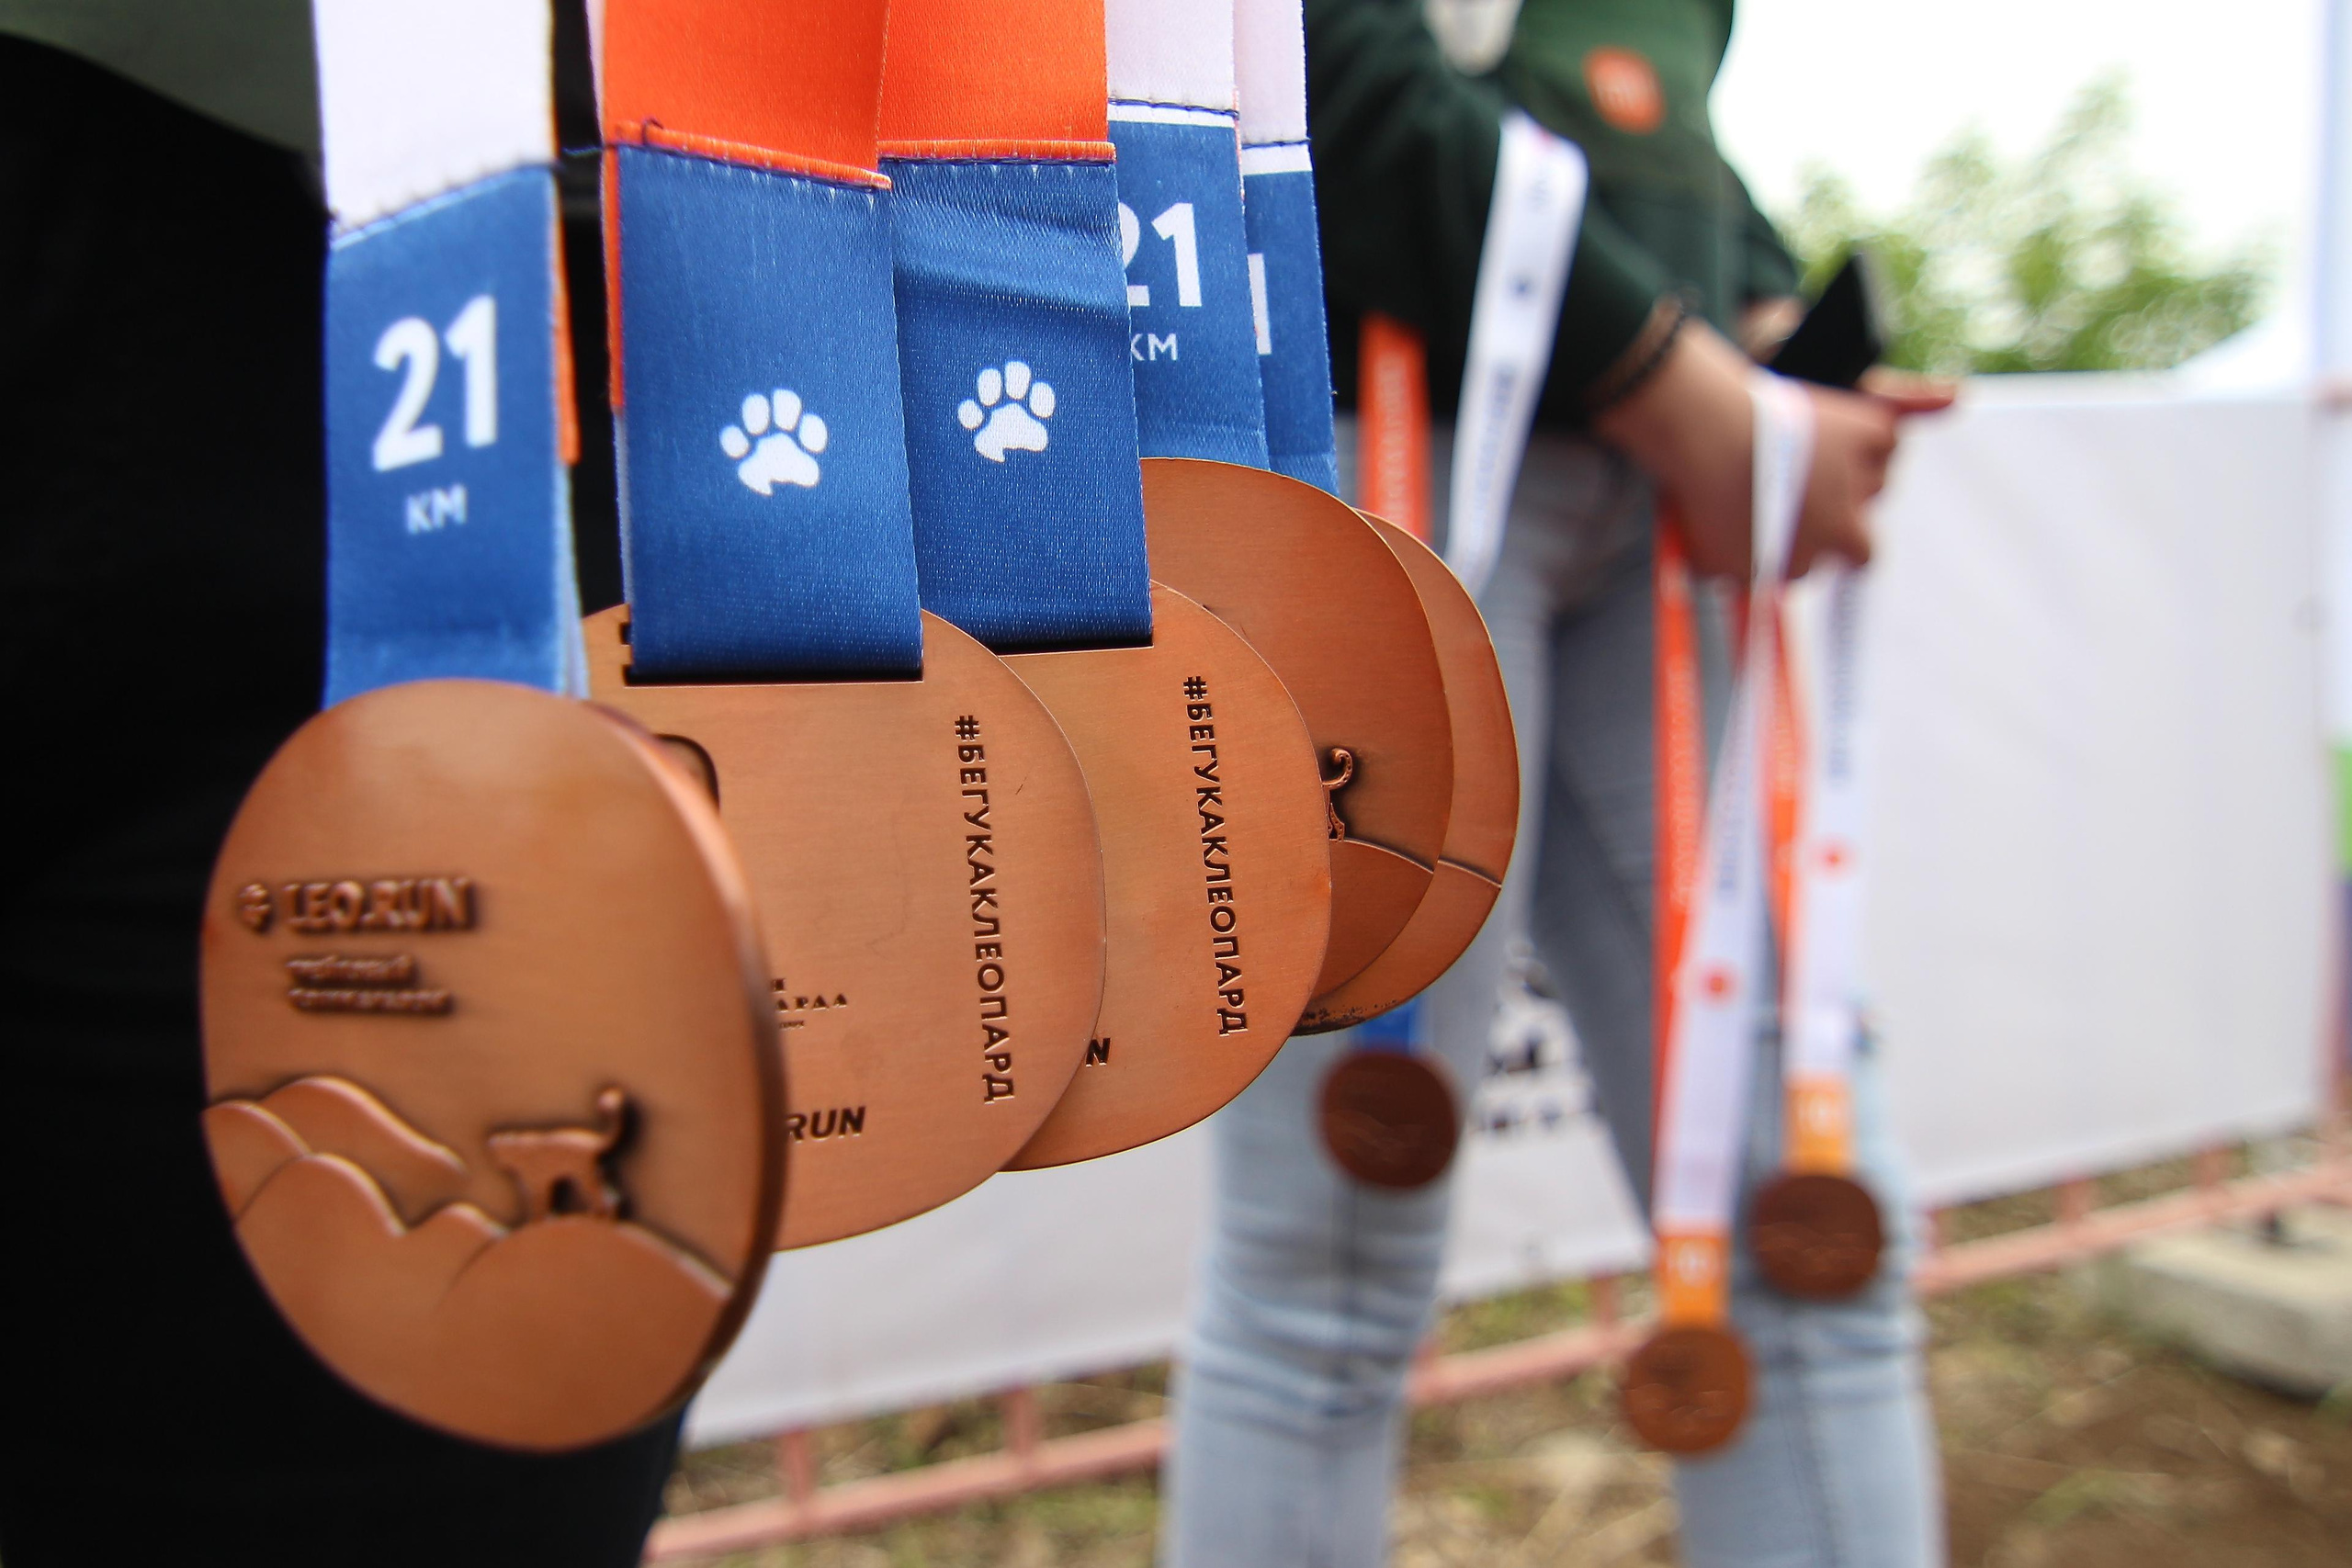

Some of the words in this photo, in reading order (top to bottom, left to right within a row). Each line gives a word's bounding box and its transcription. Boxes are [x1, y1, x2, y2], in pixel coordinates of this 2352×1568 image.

[372, 295, 497, 471] 21
[955, 715, 1015, 1105] #БЕГУКАКЛЕОПАРД
[1182, 675, 1249, 1037] #БЕГУКАКЛЕОПАРД
